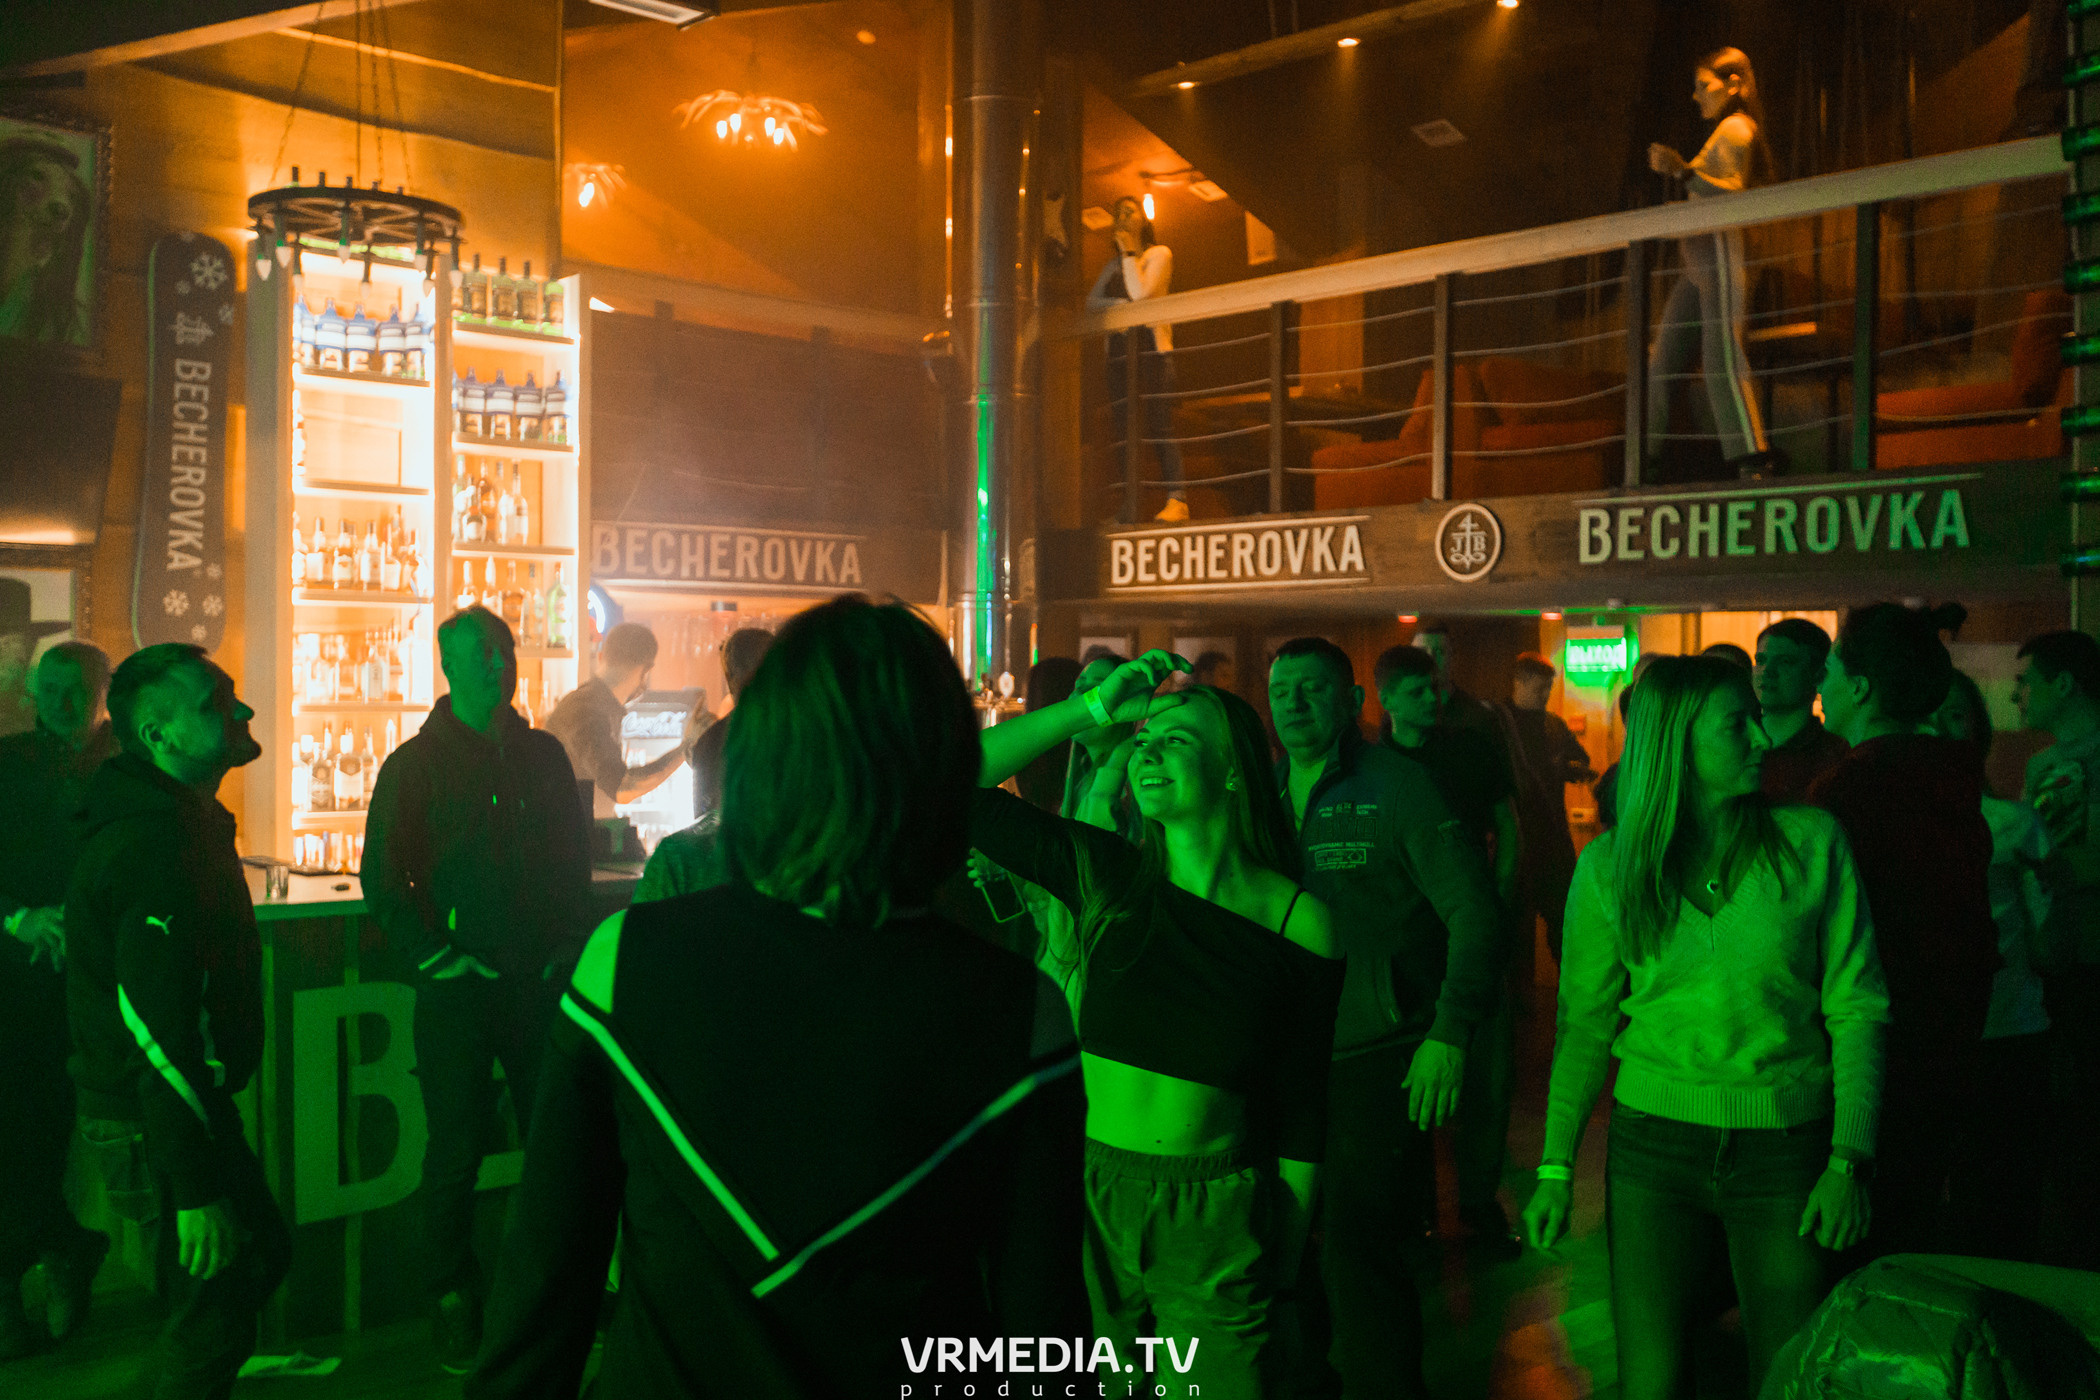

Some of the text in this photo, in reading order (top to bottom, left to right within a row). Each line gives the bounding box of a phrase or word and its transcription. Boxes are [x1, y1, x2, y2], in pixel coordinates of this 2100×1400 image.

[166, 358, 212, 572] BECHEROVKA
[592, 523, 862, 584] BECHEROVKA
[1111, 525, 1366, 586] BECHEROVKA
[1580, 489, 1970, 564] BECHEROVKA
